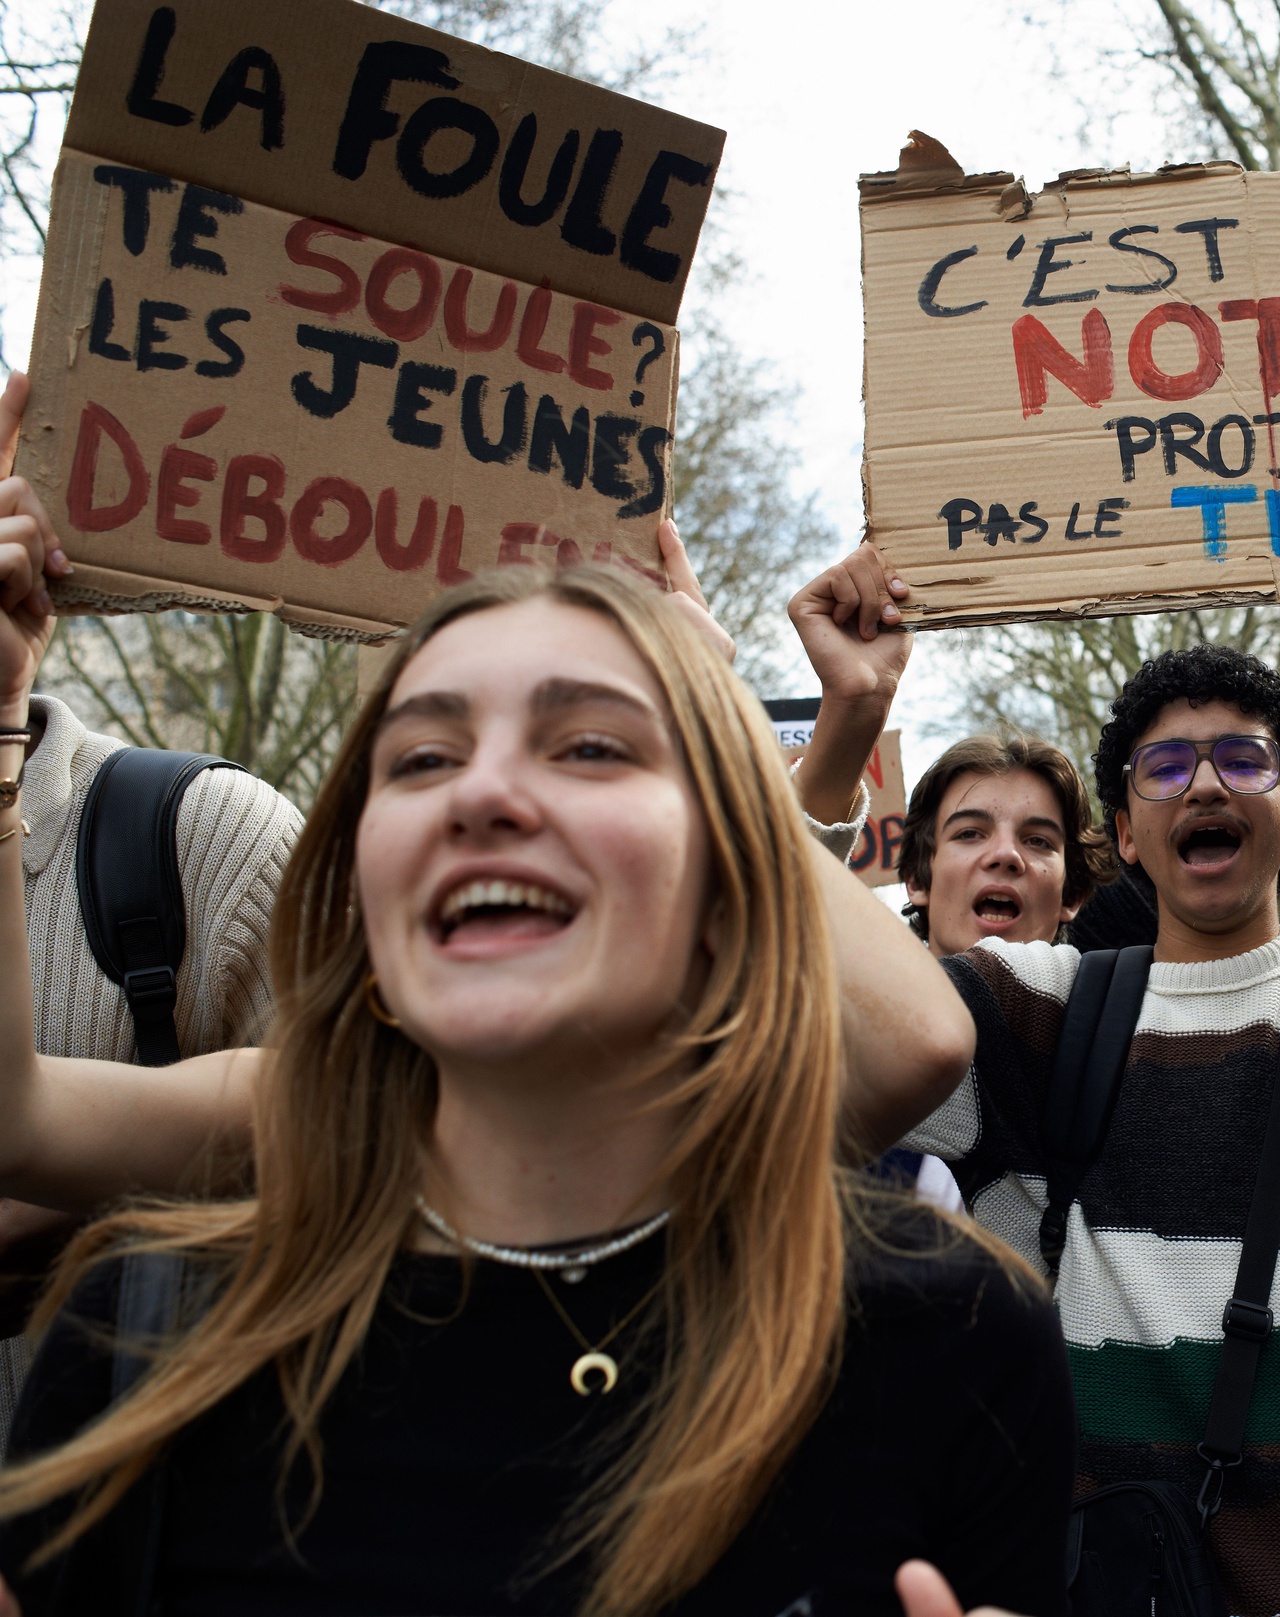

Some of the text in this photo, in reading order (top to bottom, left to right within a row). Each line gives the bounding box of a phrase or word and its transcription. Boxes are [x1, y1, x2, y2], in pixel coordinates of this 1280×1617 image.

[127, 6, 713, 283] LA FOULE
[94, 165, 244, 276] TE
[917, 218, 1239, 318] C'EST
[89, 279, 673, 520] LES JEUNES
[939, 497, 1049, 551] PAS
[1065, 497, 1131, 541] LE
